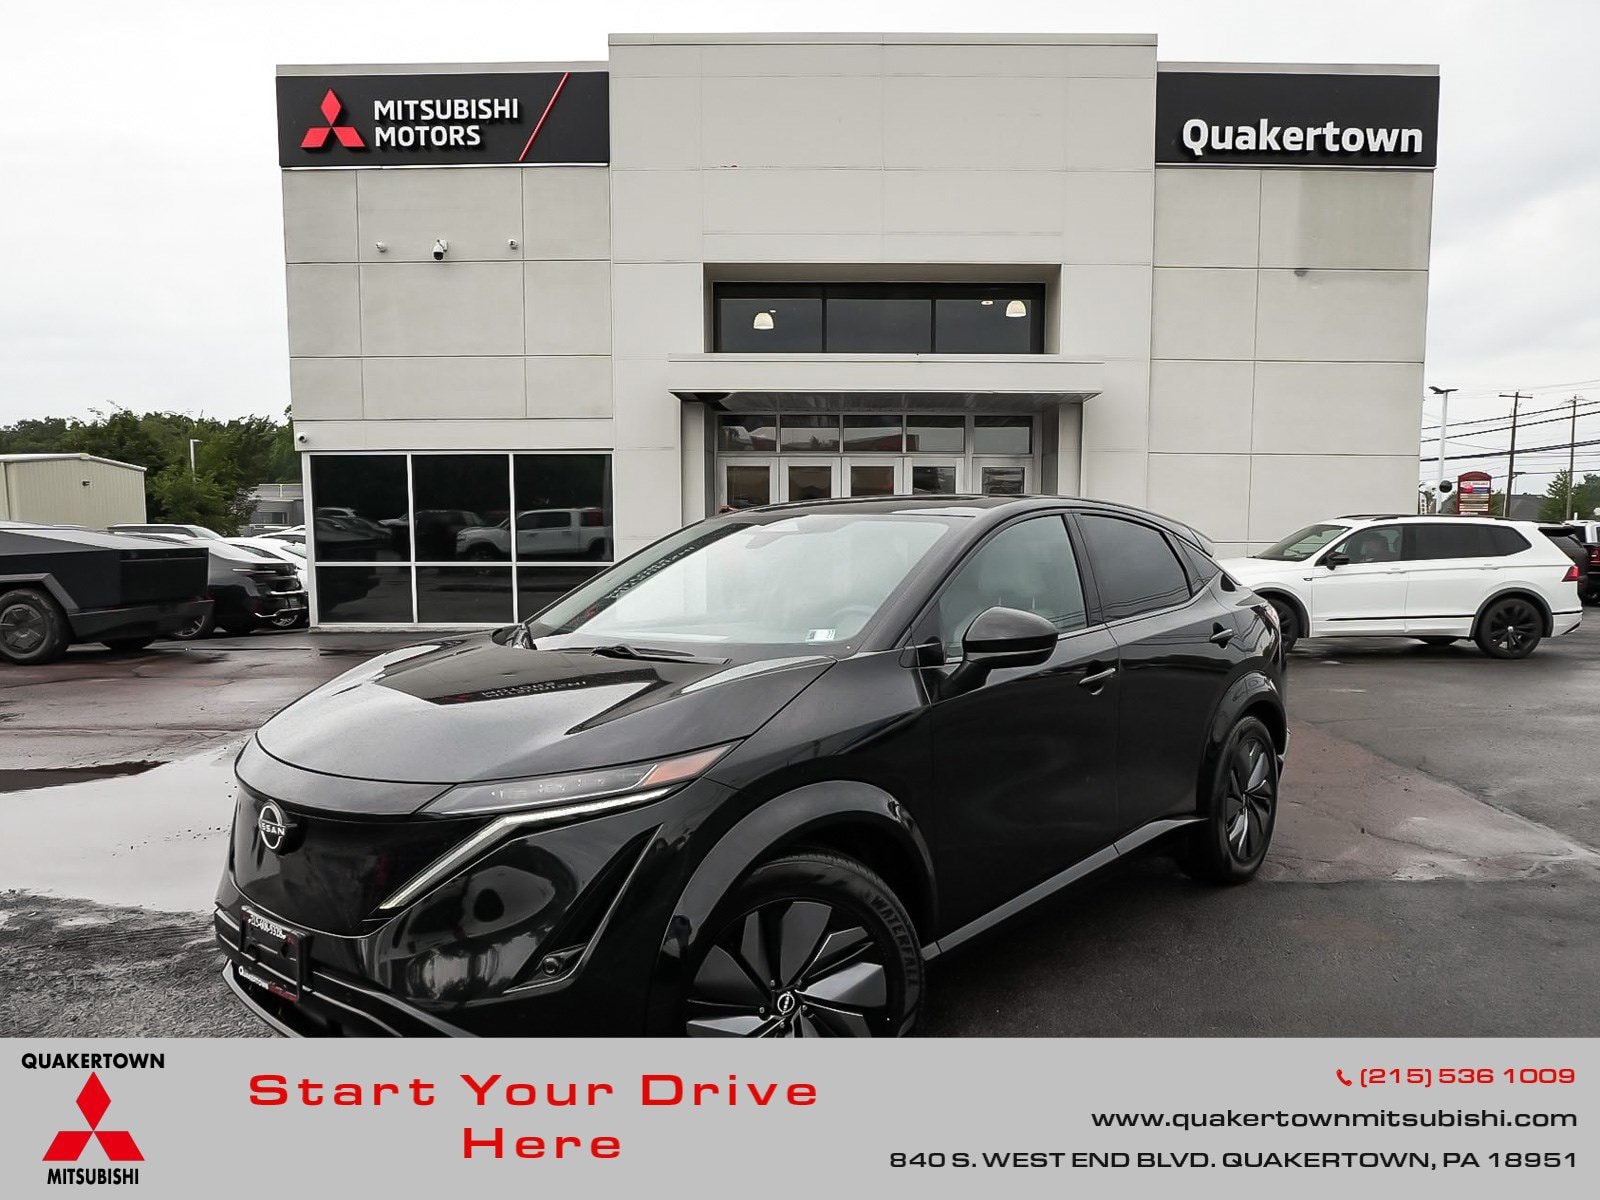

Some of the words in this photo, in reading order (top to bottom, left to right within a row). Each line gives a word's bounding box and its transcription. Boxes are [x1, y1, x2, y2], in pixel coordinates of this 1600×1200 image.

[374, 98, 519, 121] MITSUBISHI
[375, 124, 481, 147] MOTORS
[1182, 118, 1423, 156] Quakertown
